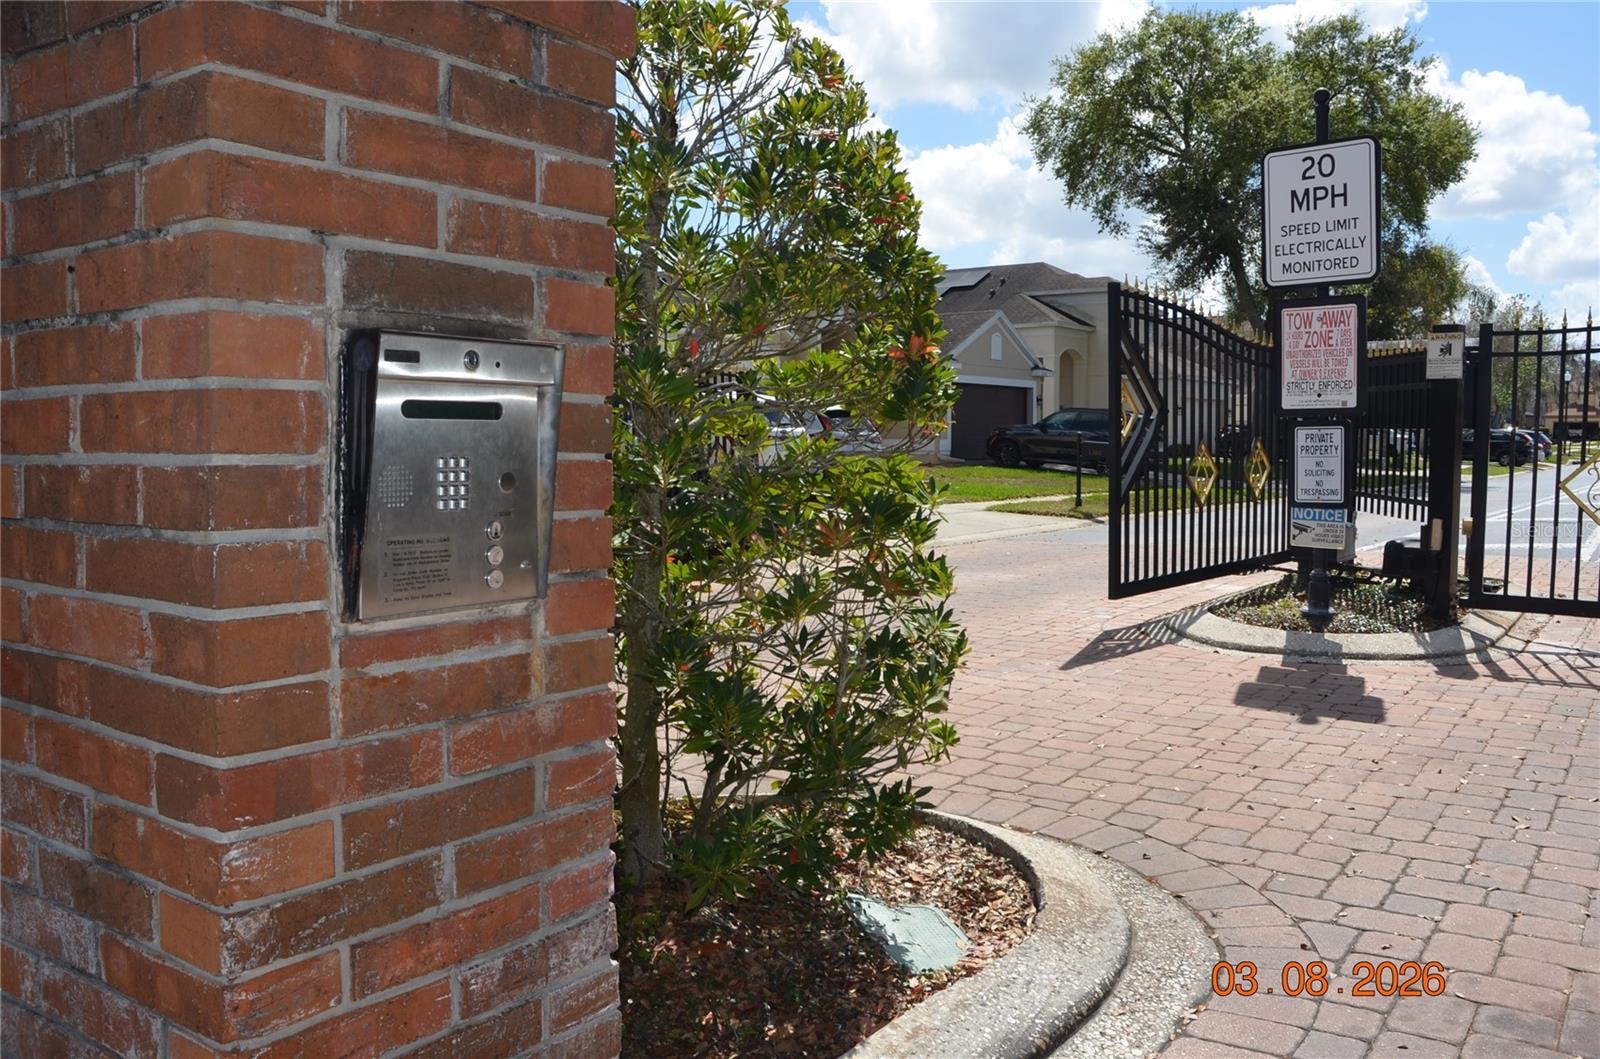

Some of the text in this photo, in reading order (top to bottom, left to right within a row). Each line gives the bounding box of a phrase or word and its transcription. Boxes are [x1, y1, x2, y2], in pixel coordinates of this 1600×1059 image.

[1301, 153, 1336, 180] 20
[1290, 183, 1348, 213] MPH
[1280, 217, 1360, 237] SPEED LIMIT
[1274, 236, 1367, 257] ELECTRICALLY
[1282, 256, 1360, 275] MONITORED
[1286, 309, 1353, 330] TOW AWAY
[1304, 330, 1334, 349] ZONE
[1286, 349, 1321, 360] UNAUTHORIZED
[1323, 348, 1345, 358] VEHICLES
[1290, 357, 1349, 369] VESSELS WILL BE TOWED
[1323, 367, 1347, 379] EXPENSE
[1286, 379, 1353, 391] STRICTLY ENFORCED
[1304, 432, 1334, 444] PRIVATE
[1300, 444, 1339, 455] PROPERTY
[1315, 460, 1324, 468] NO
[1304, 468, 1335, 477] SOLICITING
[1315, 480, 1324, 488] NO
[1300, 488, 1339, 497] TRESPASSING
[1293, 507, 1343, 522] NOTICE
